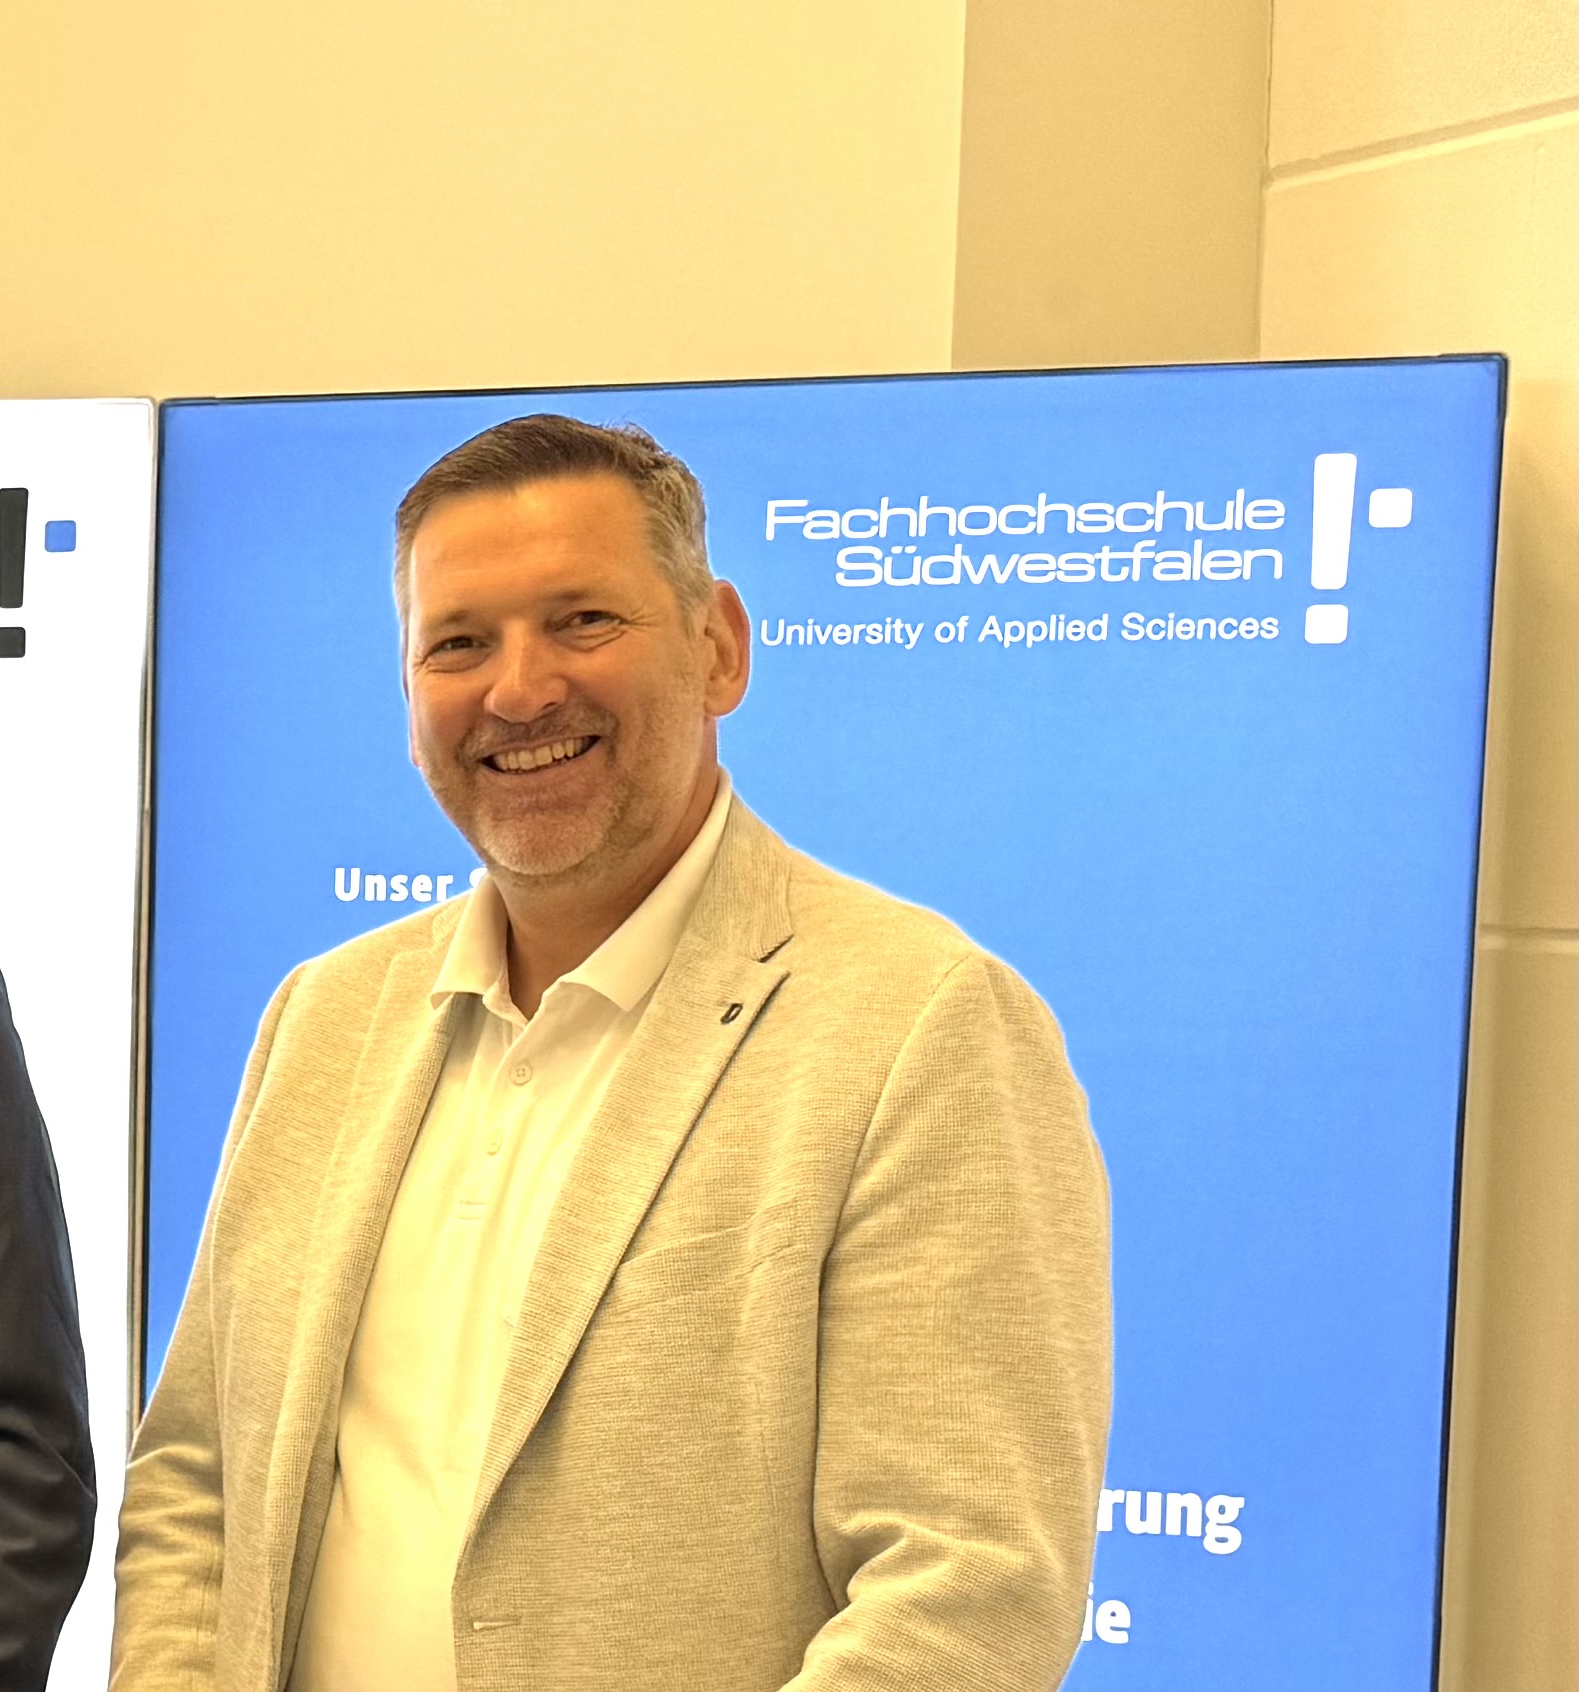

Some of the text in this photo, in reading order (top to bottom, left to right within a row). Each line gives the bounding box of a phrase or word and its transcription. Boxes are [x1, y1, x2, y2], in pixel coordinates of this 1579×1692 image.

[765, 488, 1286, 541] Fachhochschule
[835, 538, 1283, 587] Südwestfalen
[760, 611, 1279, 651] University of Applied Sciences
[334, 867, 454, 902] Unser
[1096, 1488, 1245, 1555] rung
